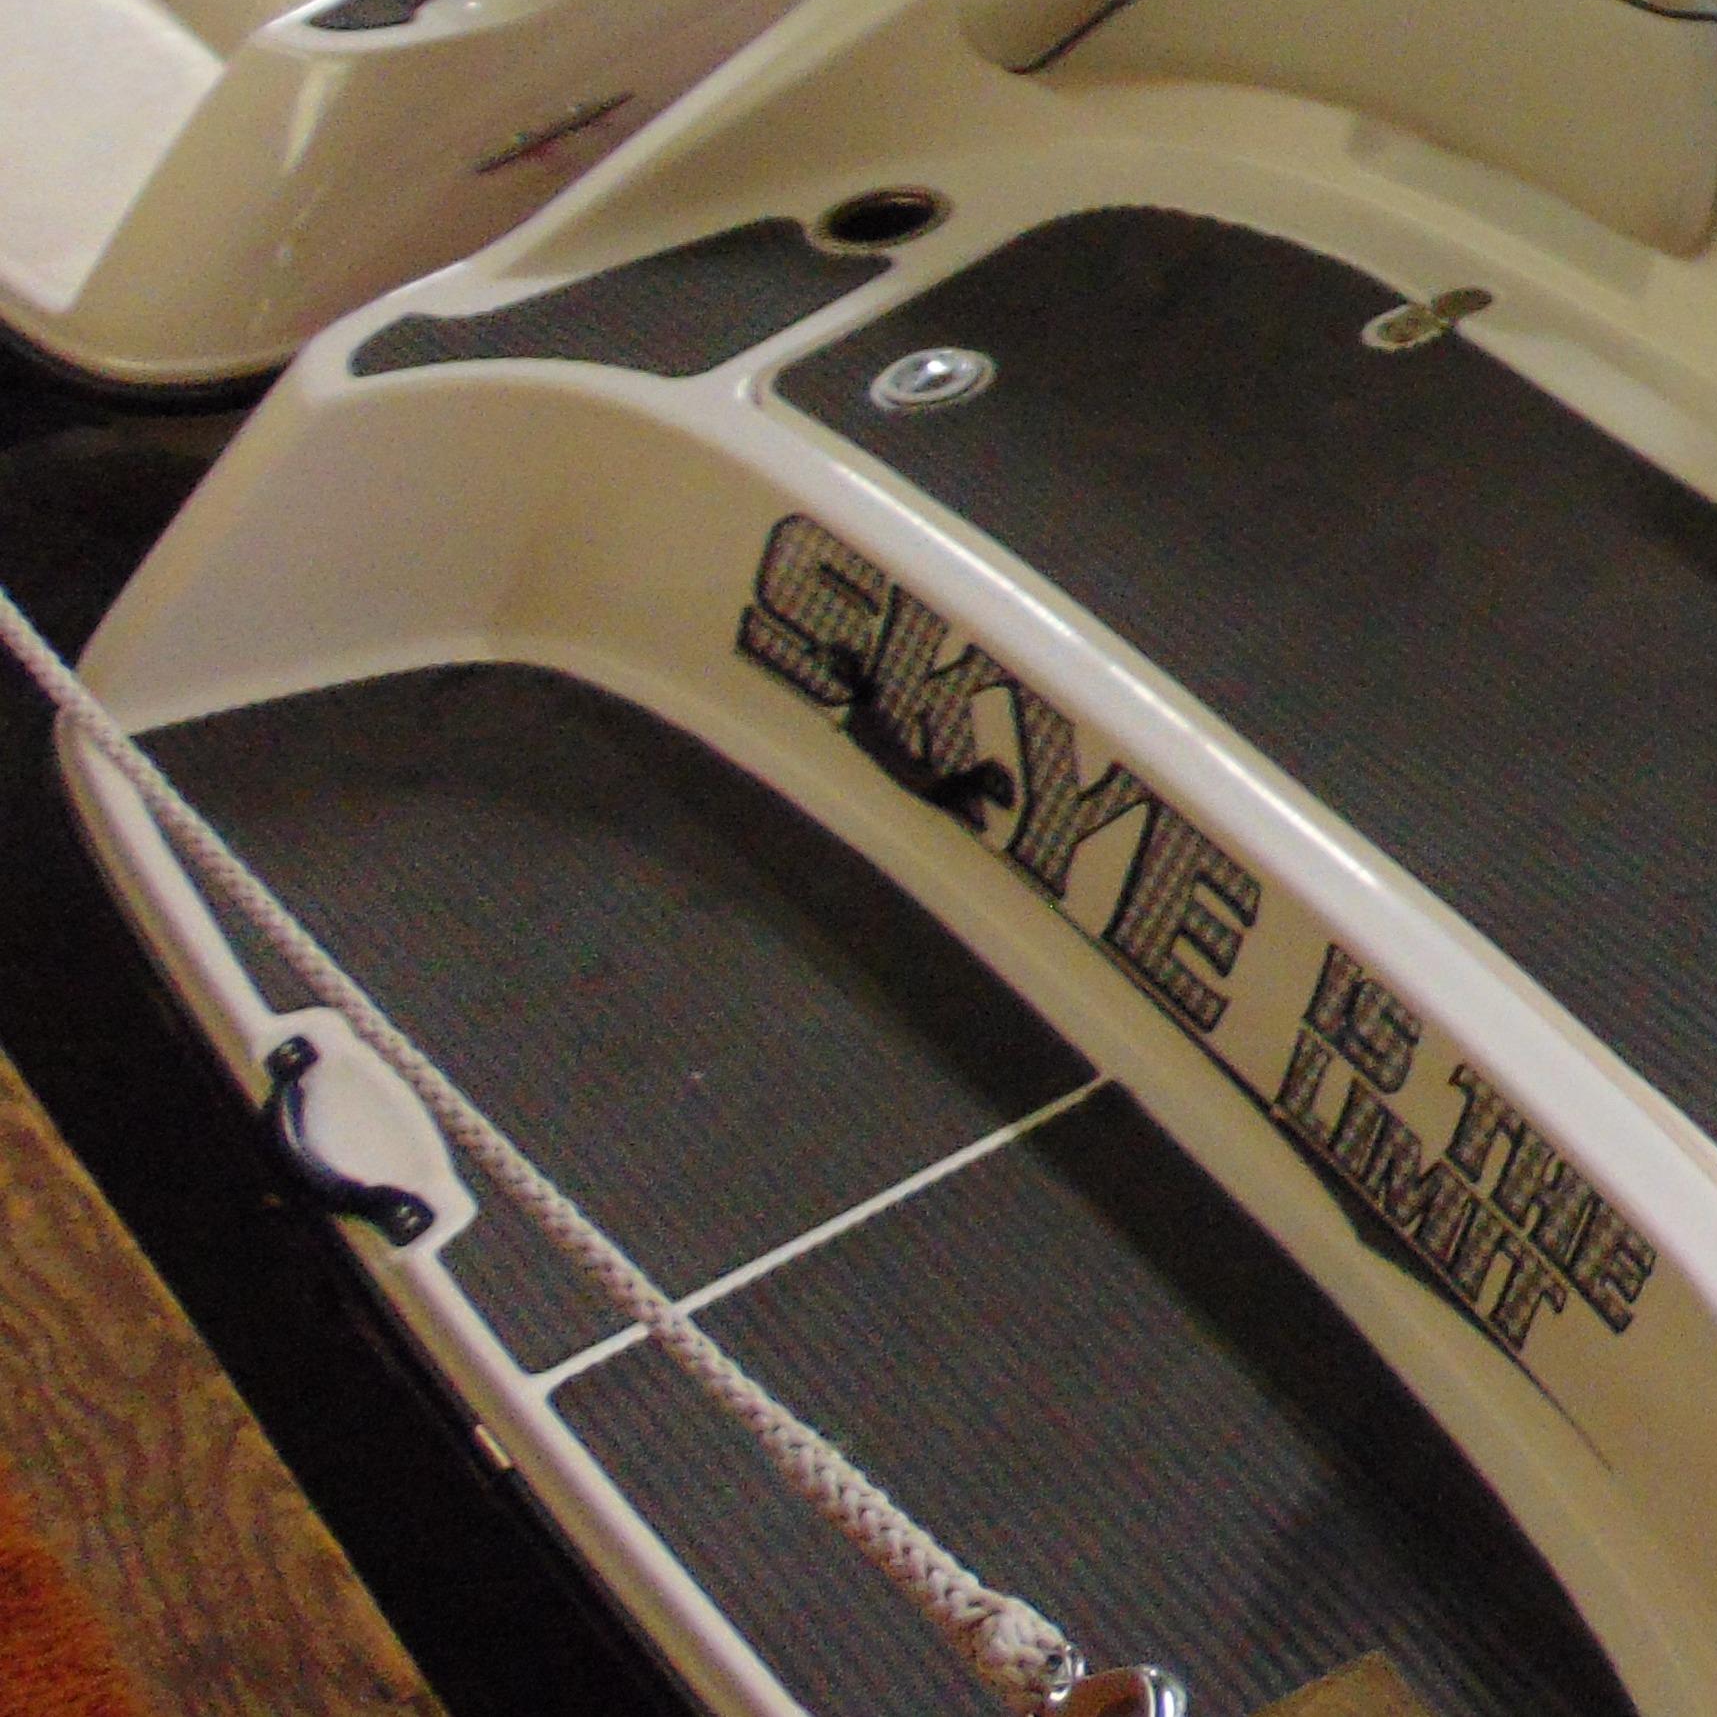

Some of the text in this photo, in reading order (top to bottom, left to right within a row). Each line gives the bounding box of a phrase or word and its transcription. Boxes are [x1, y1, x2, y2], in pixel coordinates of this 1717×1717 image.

[735, 511, 1264, 1035] SKYE
[1272, 1026, 1568, 1352] LIMIT
[1303, 942, 1657, 1335] IS THE
